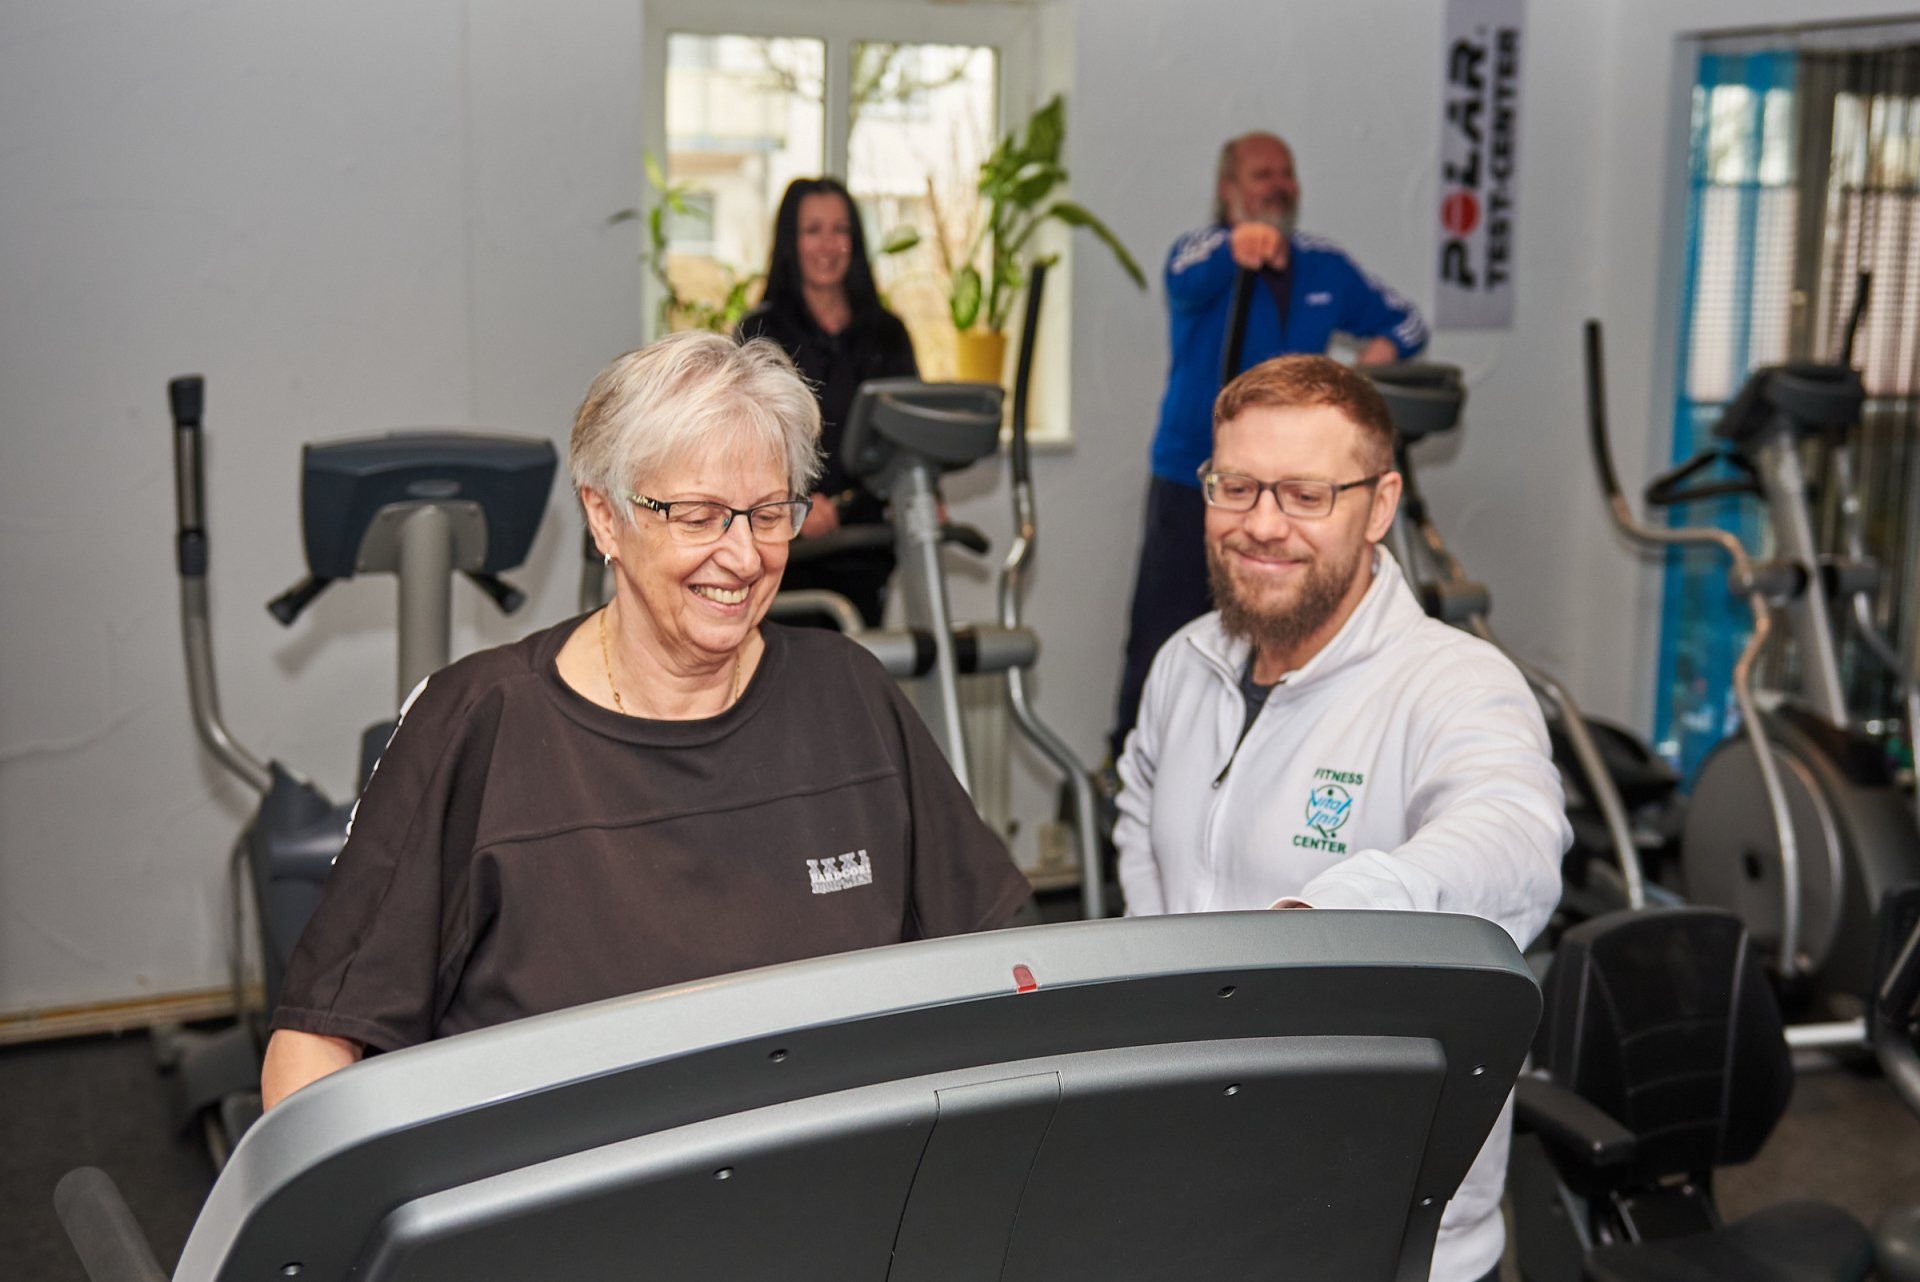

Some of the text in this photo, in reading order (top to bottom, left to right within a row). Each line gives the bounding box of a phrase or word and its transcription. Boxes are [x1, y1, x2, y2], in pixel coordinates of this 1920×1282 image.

[1440, 37, 1485, 291] POLAR
[1485, 28, 1520, 291] TEST-CENTER
[1293, 834, 1347, 854] CENTER
[1314, 767, 1364, 785] FITNESS
